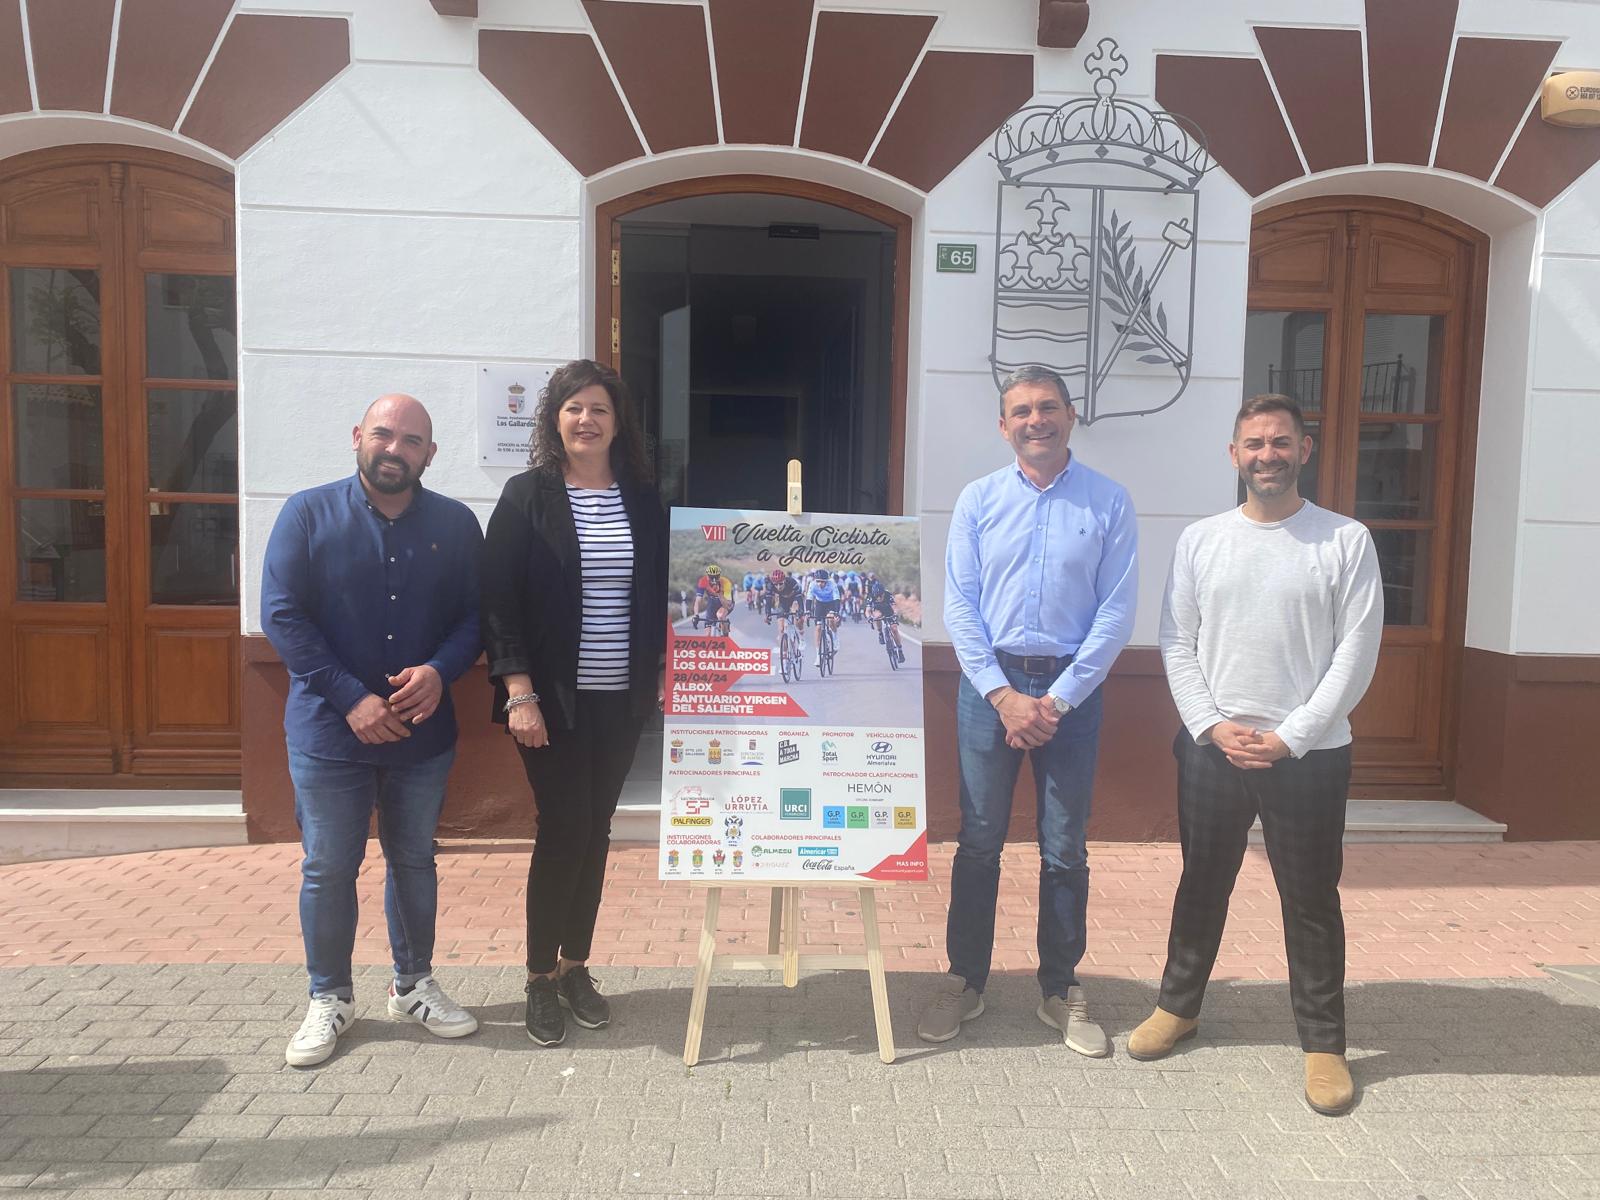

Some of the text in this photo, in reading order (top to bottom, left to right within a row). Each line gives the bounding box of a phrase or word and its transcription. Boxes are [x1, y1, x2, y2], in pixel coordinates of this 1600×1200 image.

[951, 250, 972, 265] 65
[702, 523, 891, 547] VIII Vuelta Ciclista
[757, 546, 865, 567] a Almería
[673, 640, 726, 650] 27/04/24
[673, 650, 769, 660] LOS GALLARDOS
[673, 661, 769, 672] LOS GALLARDOS
[673, 673, 728, 683] 28/04/24
[673, 683, 712, 692] ALBOX
[673, 694, 787, 705] SANTUARIO VIRGEN
[672, 704, 754, 714] DEL SALIENTE
[731, 795, 762, 803] LÓPEZ
[725, 803, 768, 811] URRUTIA
[784, 804, 807, 813] URCI
[673, 817, 711, 825] PALFINGER
